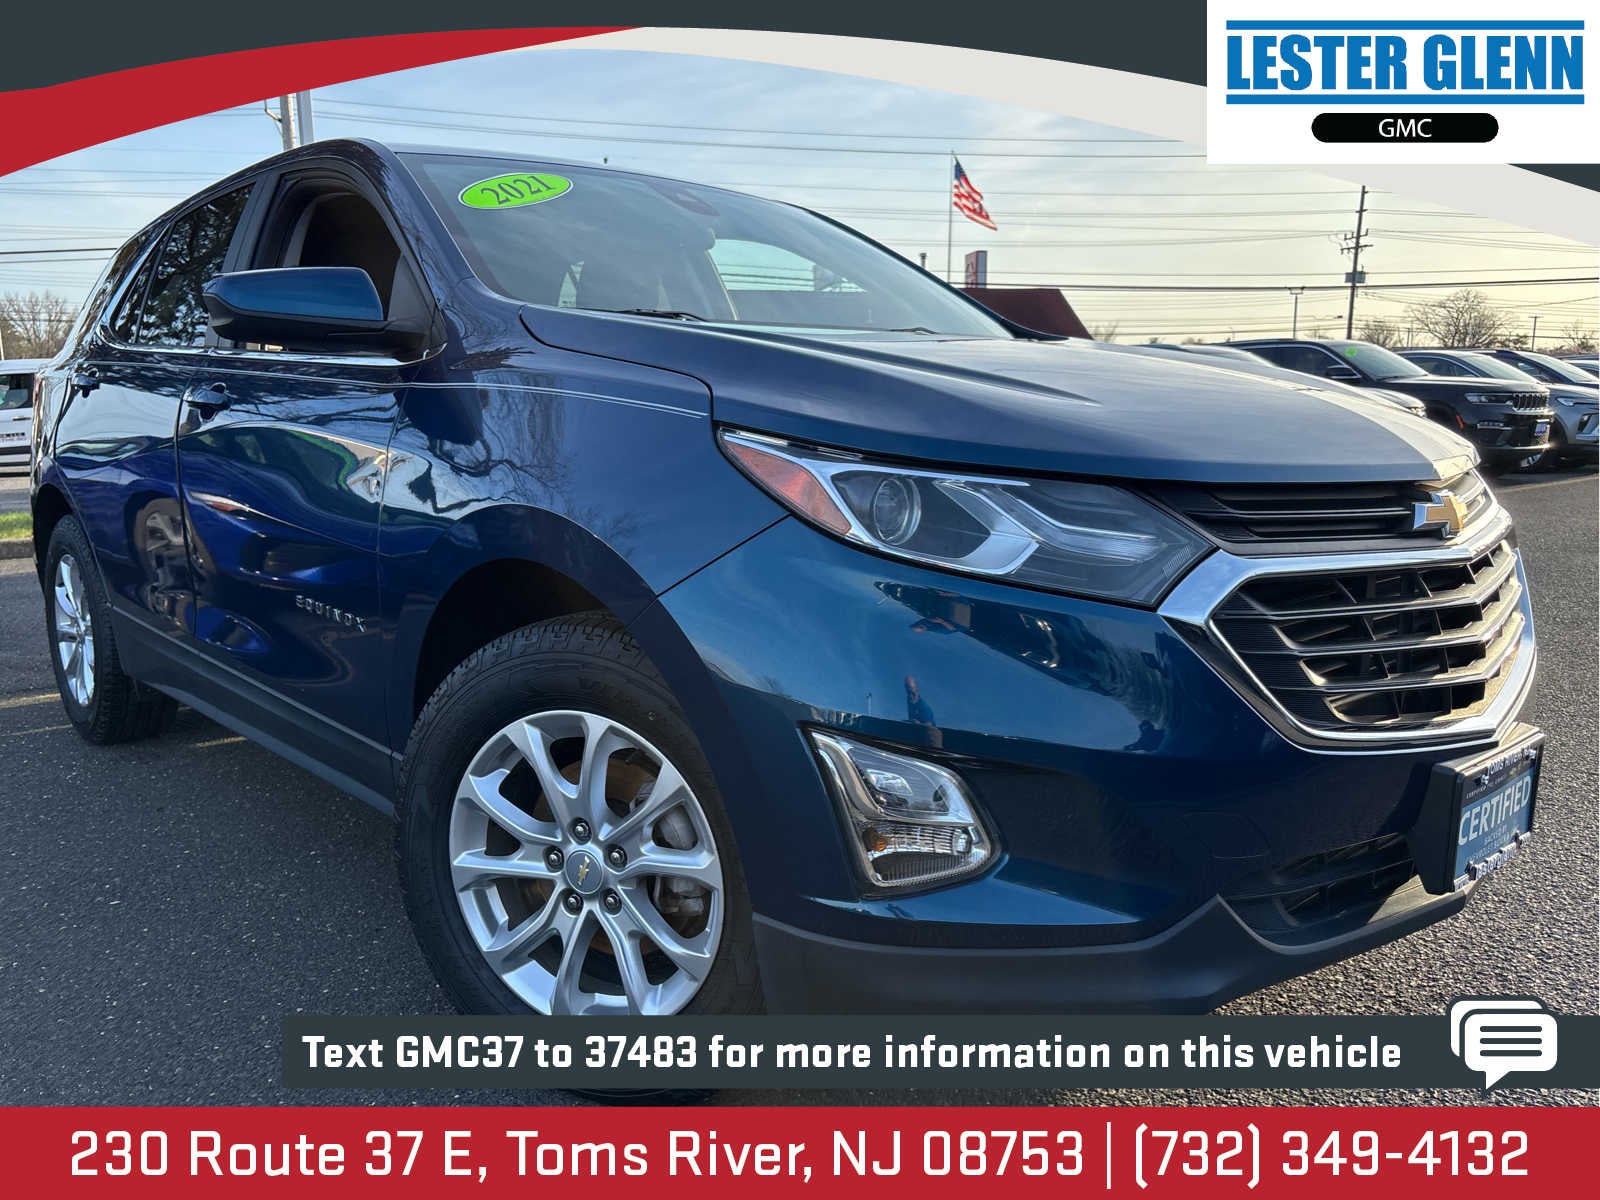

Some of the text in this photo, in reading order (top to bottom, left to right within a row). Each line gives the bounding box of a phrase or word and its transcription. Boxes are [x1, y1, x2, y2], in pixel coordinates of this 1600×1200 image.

[480, 175, 557, 206] 2021
[296, 595, 368, 632] EQUINOX
[1458, 775, 1532, 846] CERTIFIED
